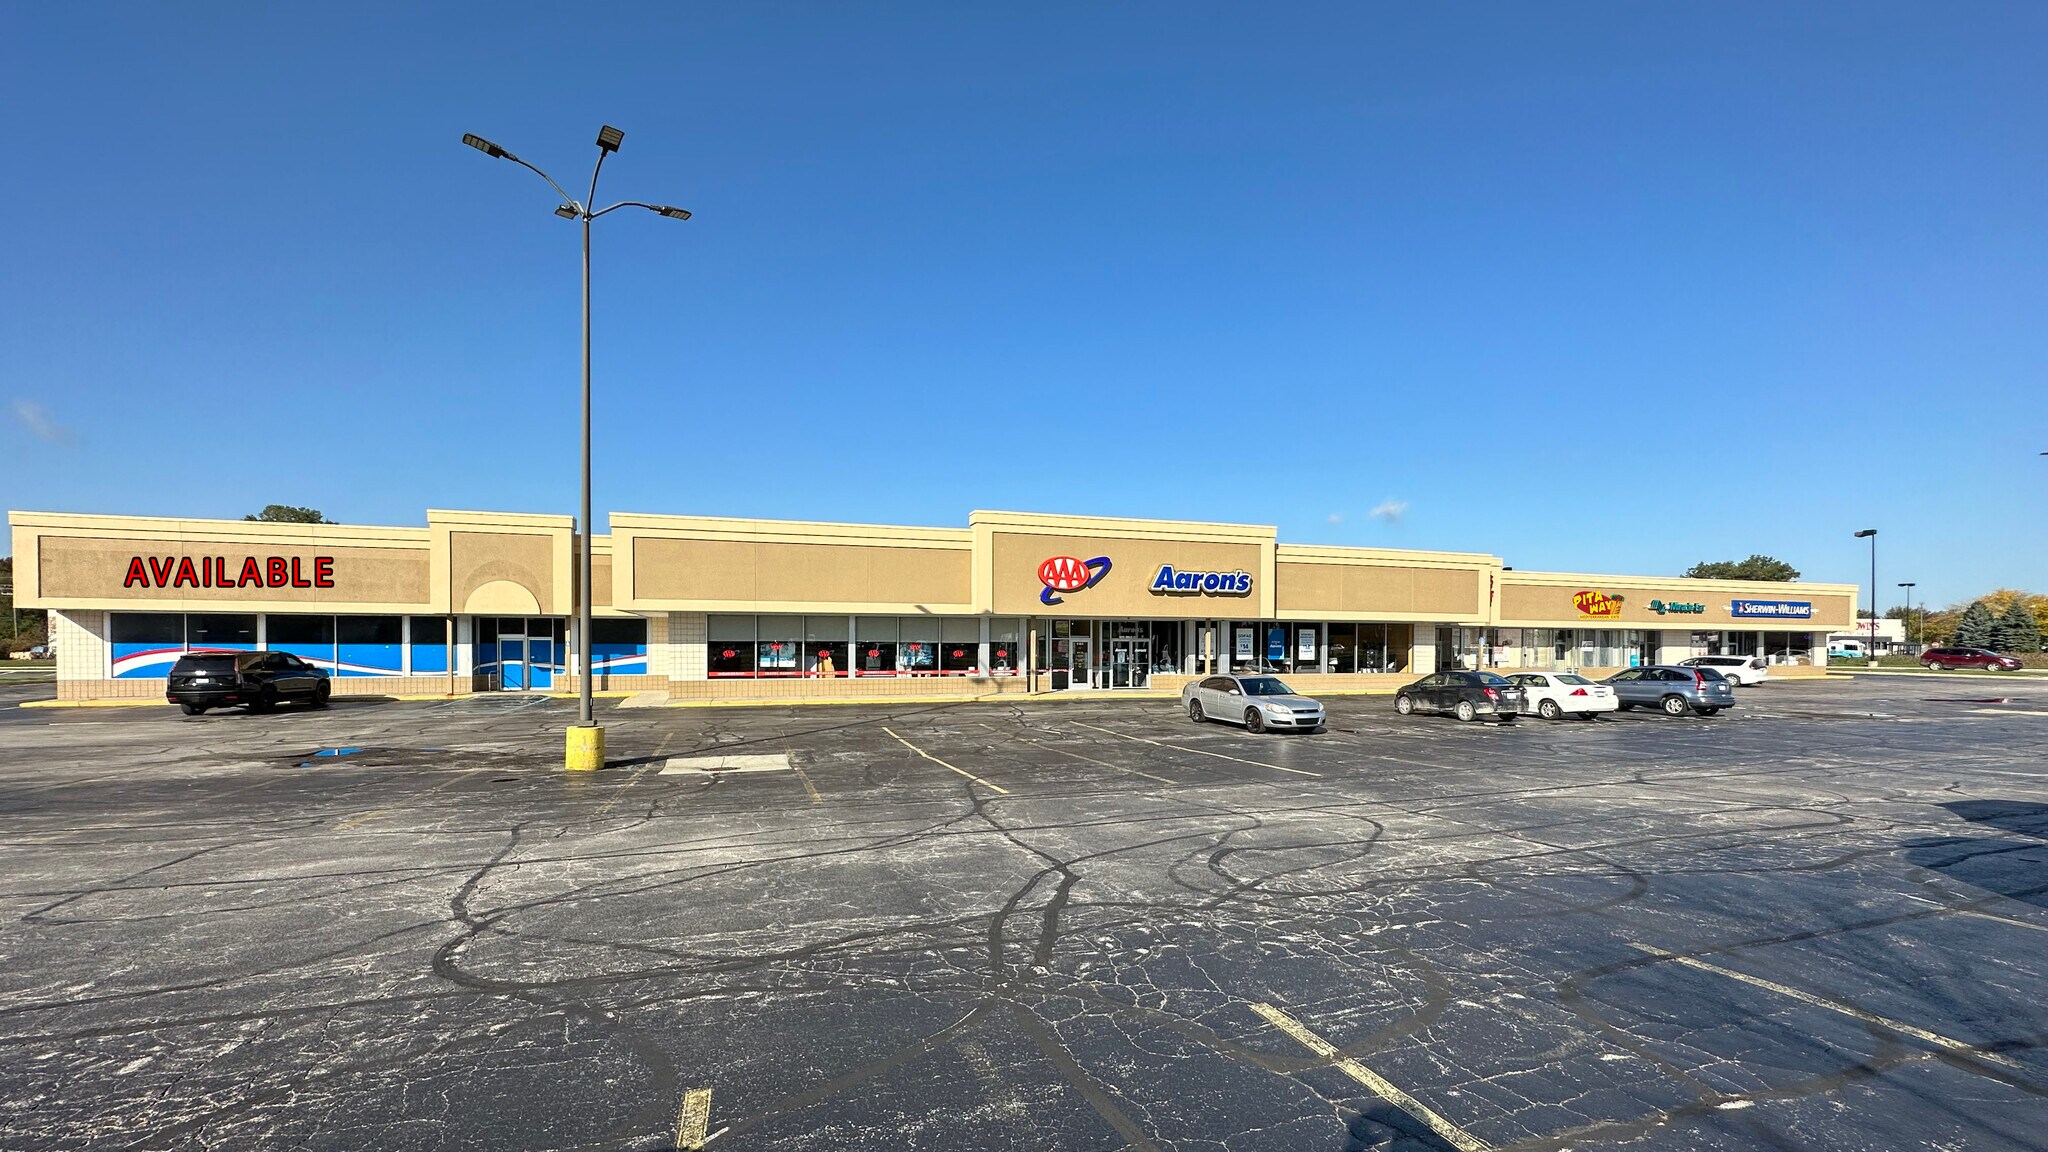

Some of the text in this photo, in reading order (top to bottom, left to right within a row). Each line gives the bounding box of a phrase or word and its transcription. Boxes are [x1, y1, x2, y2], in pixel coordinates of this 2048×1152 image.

[123, 556, 335, 588] AVAILABLE
[1042, 556, 1086, 589] AAA
[1153, 565, 1252, 592] Aaron's
[1573, 590, 1603, 609] PITA
[1589, 600, 1612, 615] WAY
